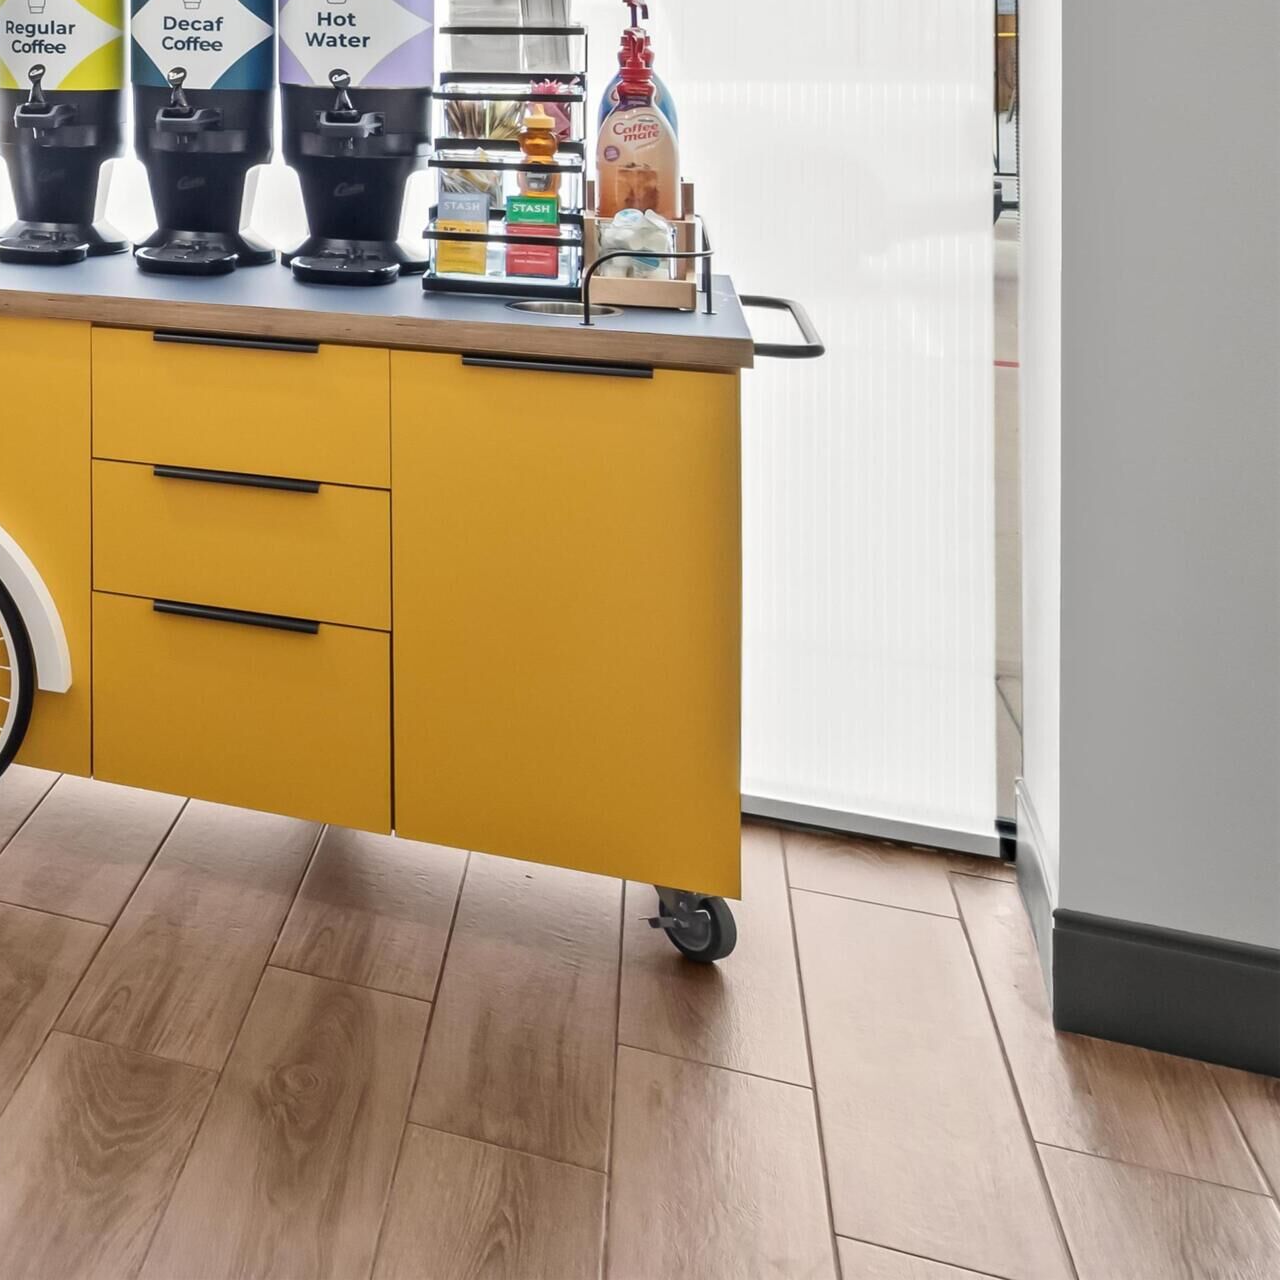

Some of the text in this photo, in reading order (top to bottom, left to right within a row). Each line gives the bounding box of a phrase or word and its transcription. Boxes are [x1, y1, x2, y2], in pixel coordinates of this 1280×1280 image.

[163, 15, 224, 32] Decaf
[317, 11, 357, 27] Hot
[5, 20, 76, 38] Regular
[11, 39, 67, 54] Coffee
[161, 35, 223, 52] Coffee
[305, 31, 371, 48] Water
[612, 122, 659, 135] Coffee
[623, 130, 660, 142] mate
[443, 201, 480, 211] STASH
[512, 203, 550, 214] STASH
